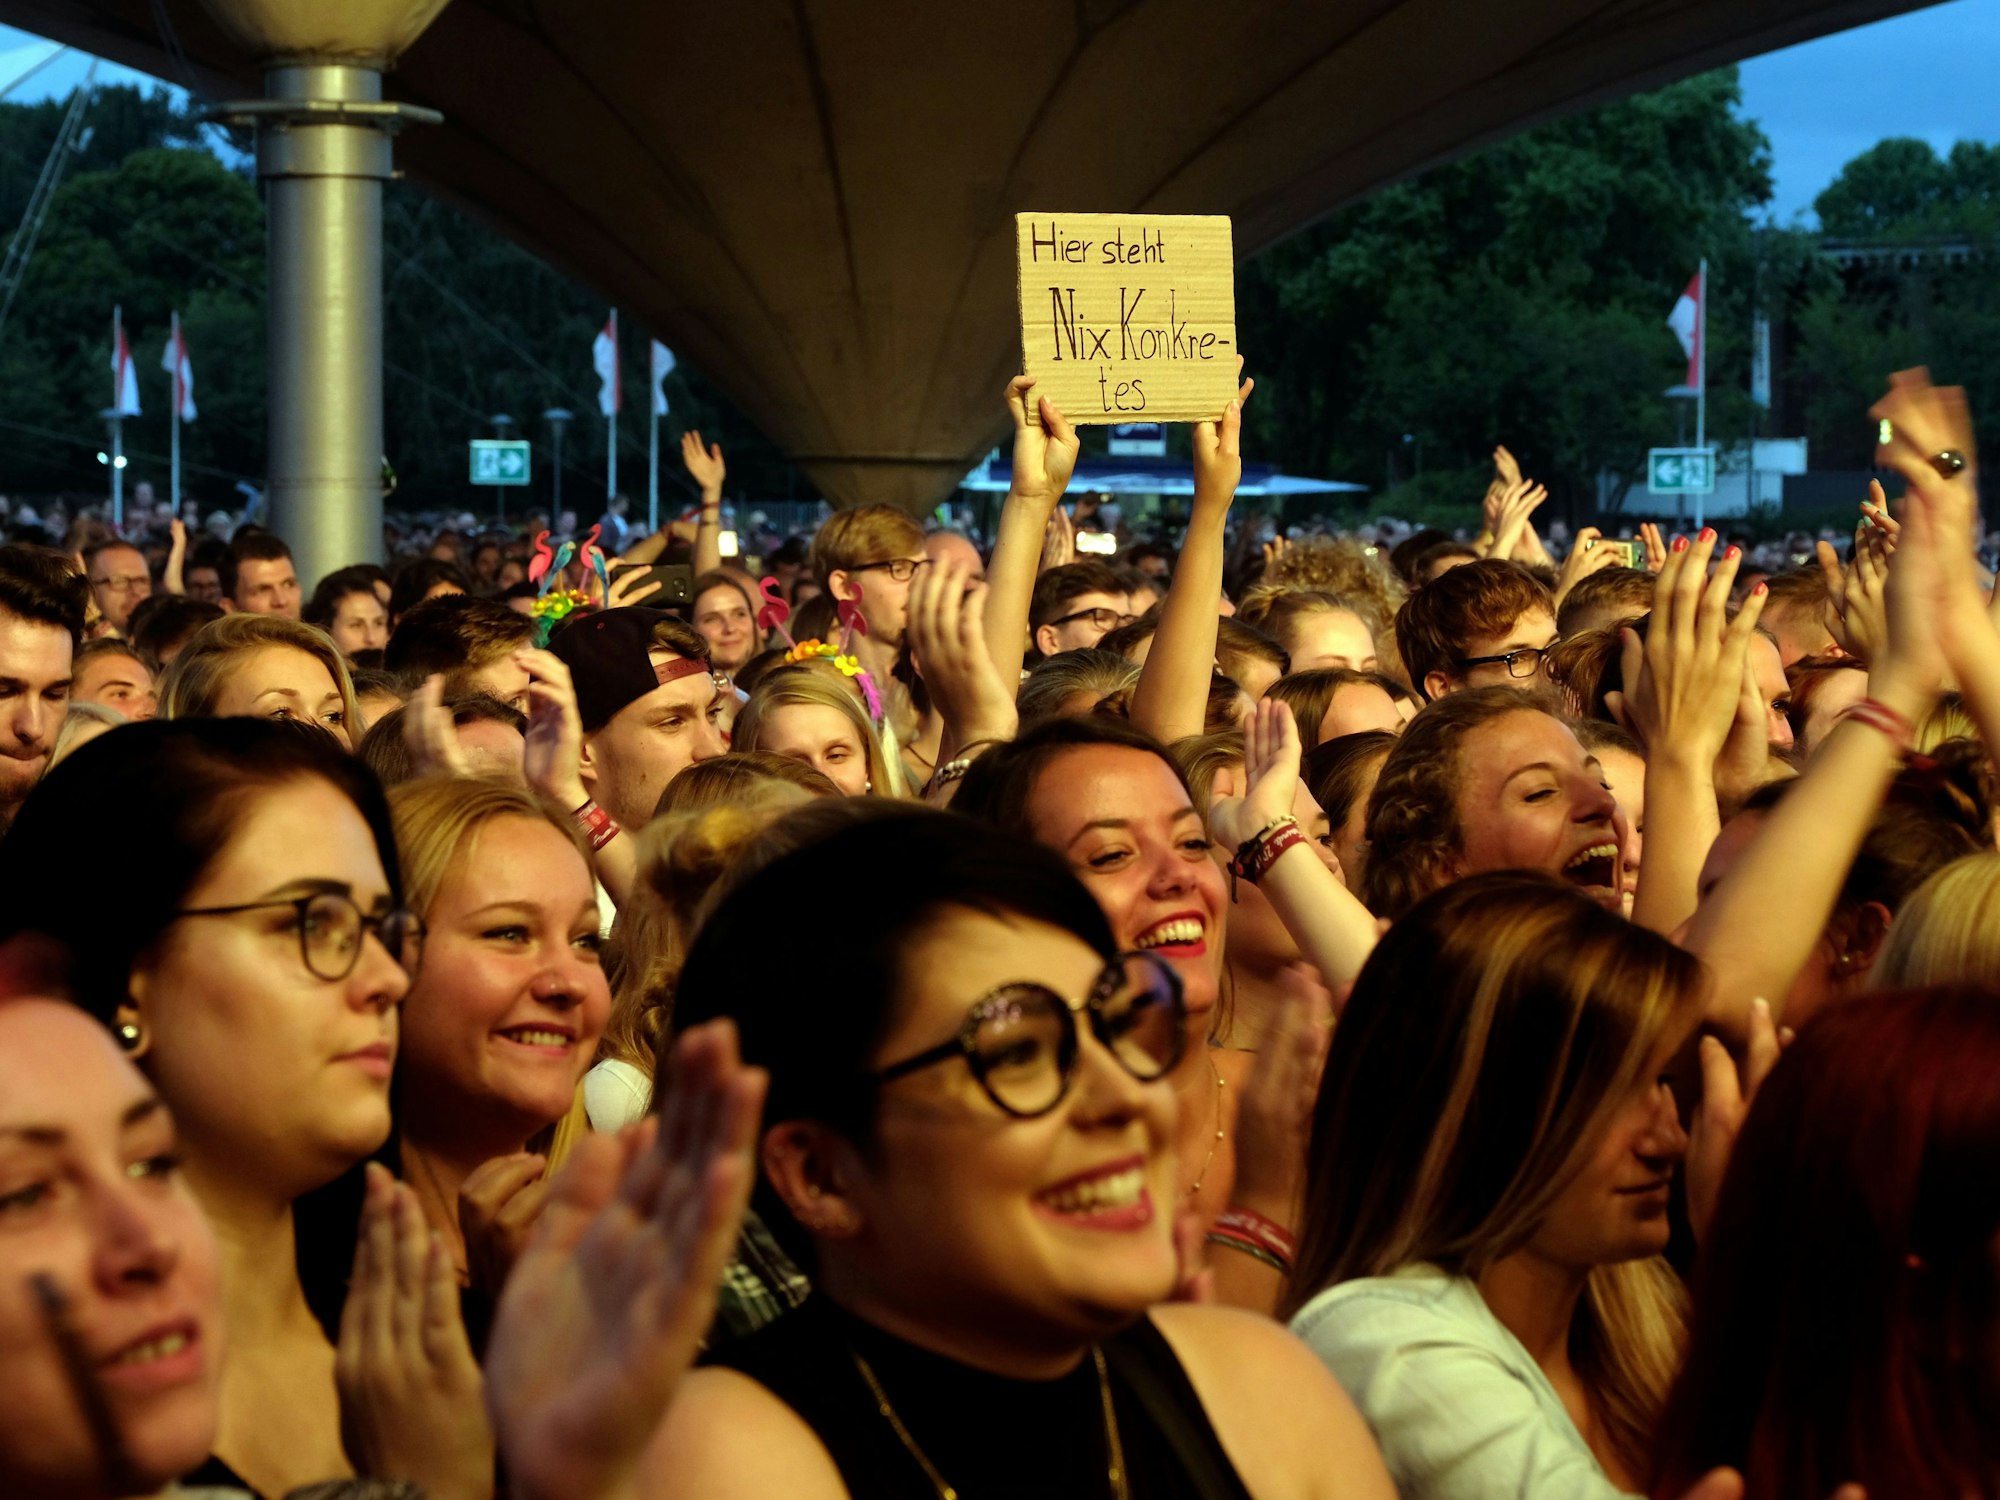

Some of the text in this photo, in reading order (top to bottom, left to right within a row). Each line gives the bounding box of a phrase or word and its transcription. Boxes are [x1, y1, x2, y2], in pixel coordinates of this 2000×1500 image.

[1032, 221, 1165, 264] Hier steht
[1048, 287, 1230, 361] Nix Konkre-
[1099, 365, 1145, 412] tes
